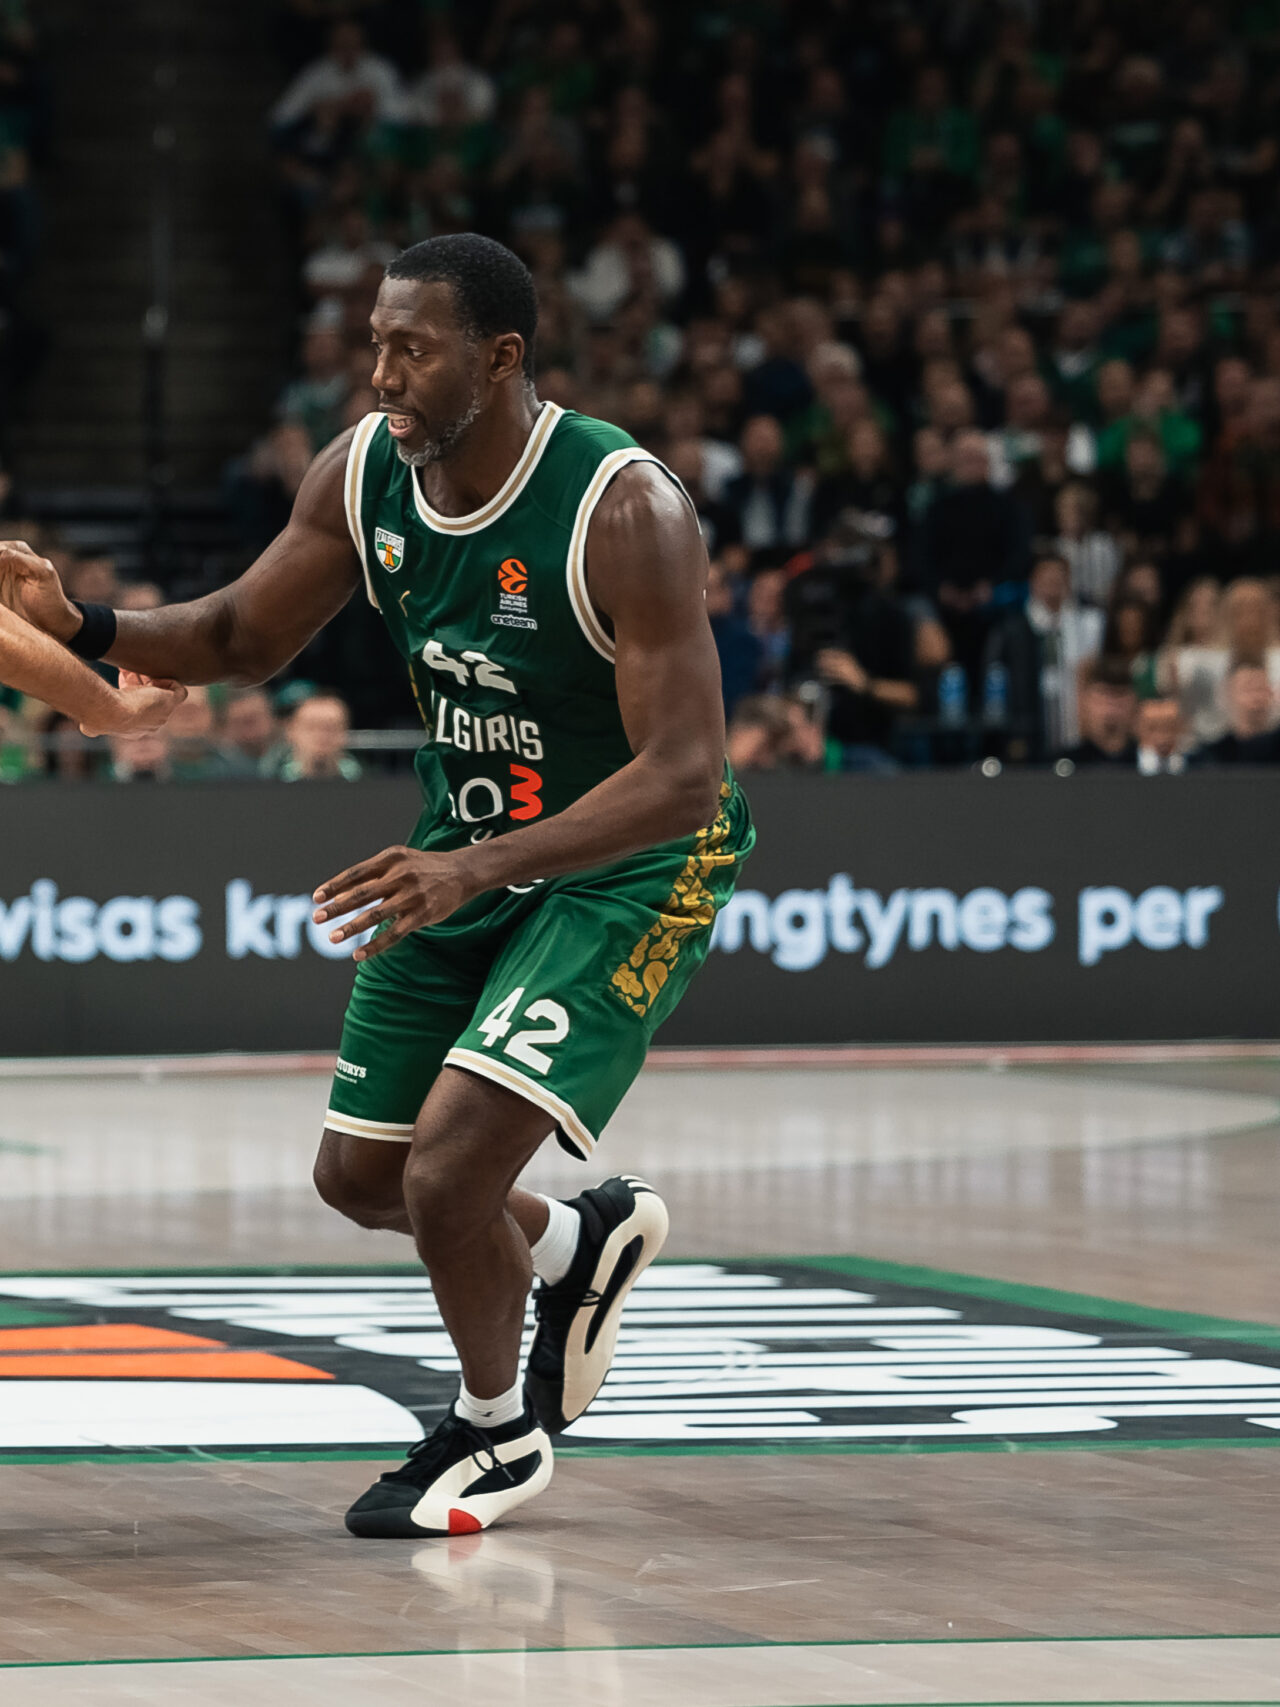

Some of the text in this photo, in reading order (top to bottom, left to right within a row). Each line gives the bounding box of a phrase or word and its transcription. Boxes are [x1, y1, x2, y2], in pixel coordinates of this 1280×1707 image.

[422, 640, 518, 695] 42
[431, 690, 544, 760] LGIRIS
[709, 872, 1056, 972] ngtynes
[1078, 885, 1224, 967] per
[477, 987, 570, 1076] 42
